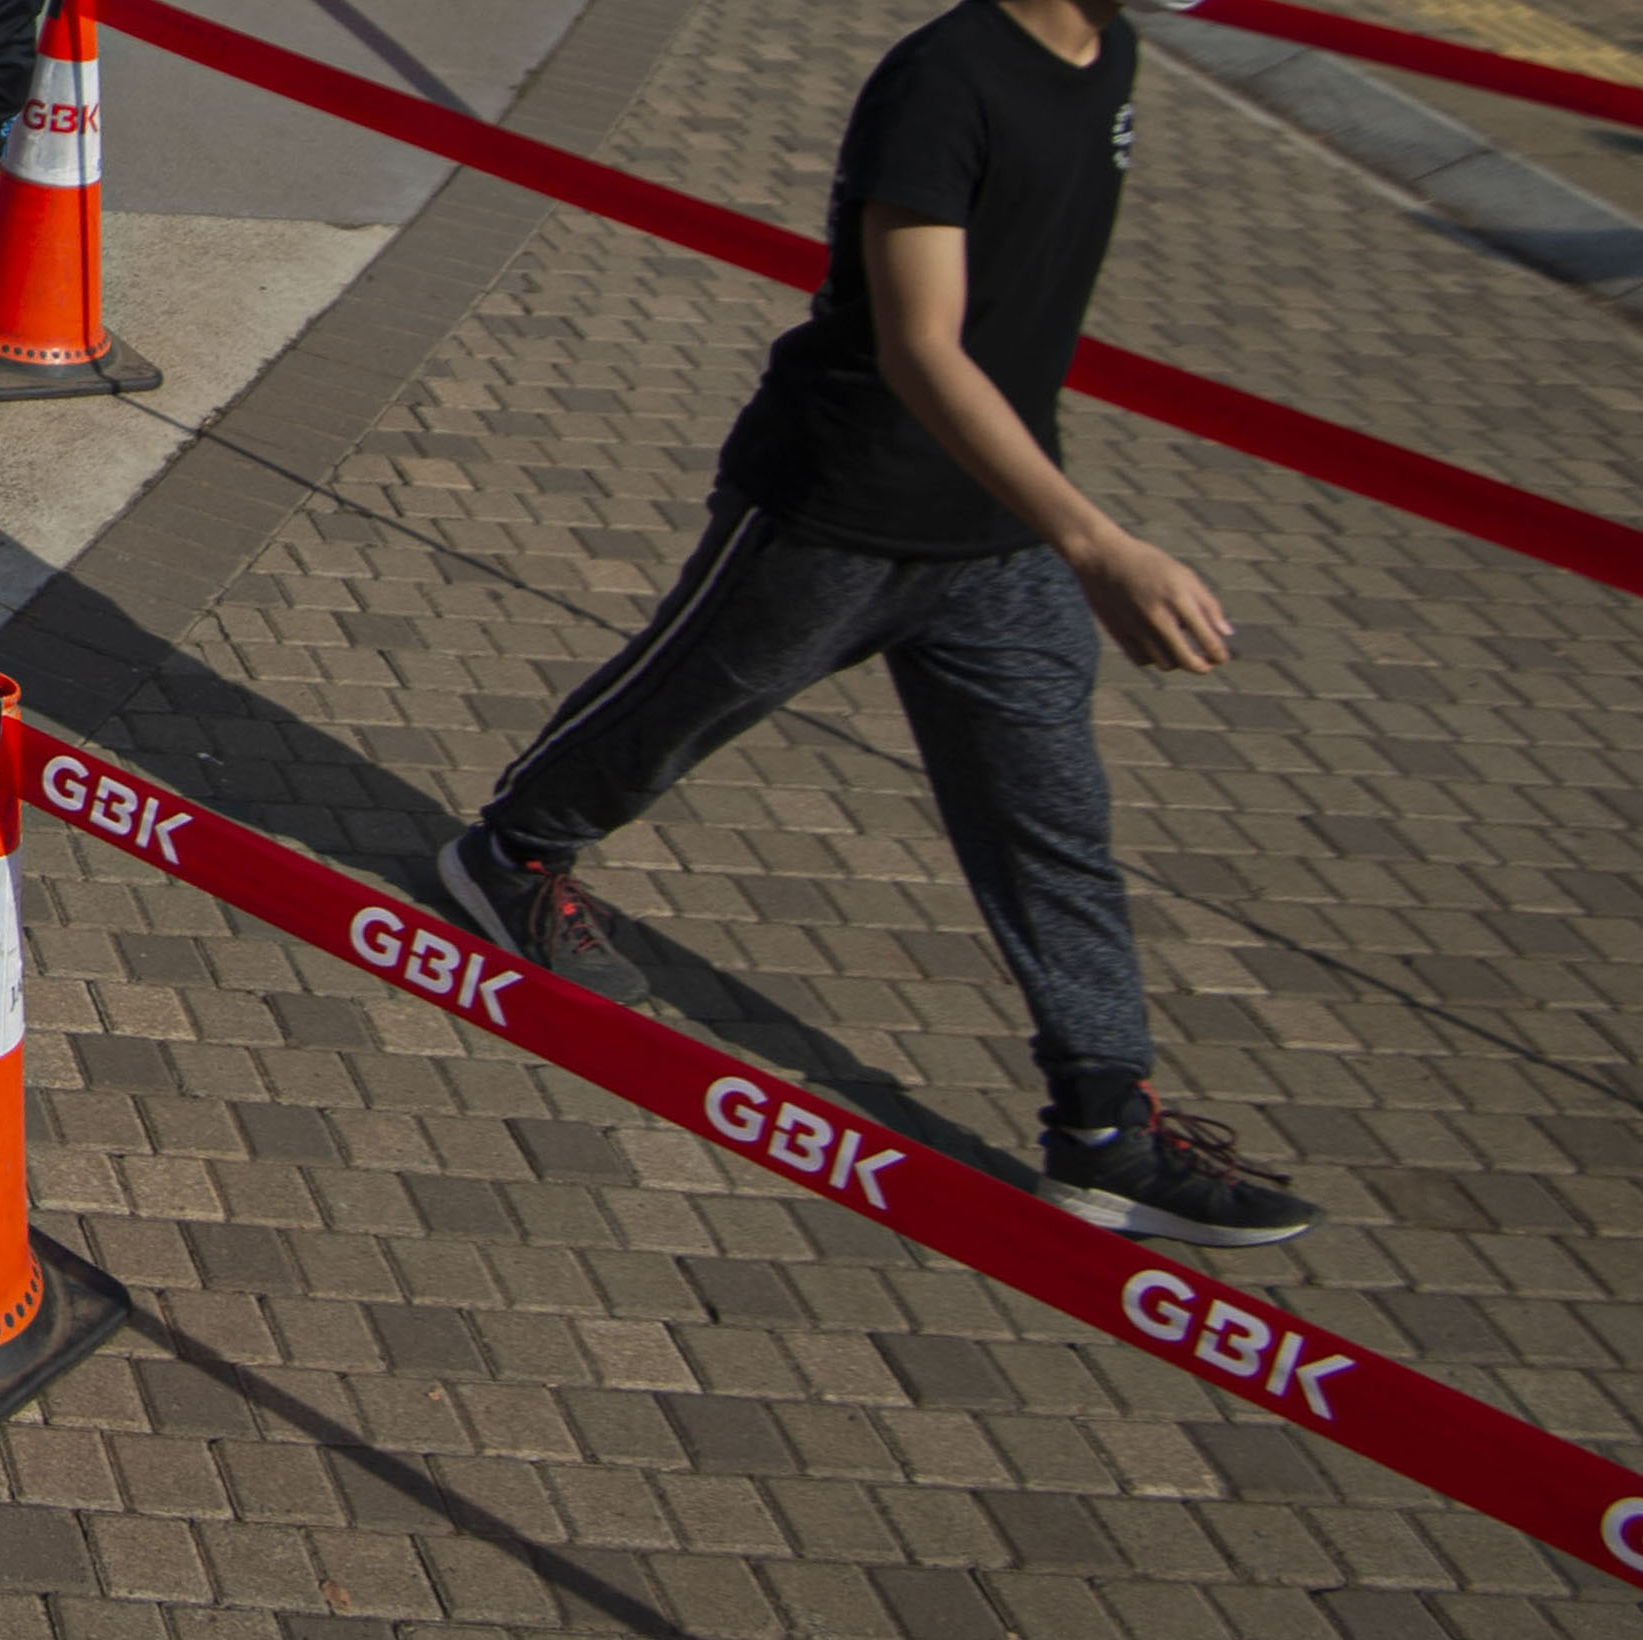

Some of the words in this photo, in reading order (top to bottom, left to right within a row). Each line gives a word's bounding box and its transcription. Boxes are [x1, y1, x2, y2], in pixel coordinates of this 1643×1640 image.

[23, 98, 100, 135] GBK
[42, 754, 193, 864] GBK
[349, 905, 523, 1028] GBK
[702, 1072, 909, 1212] GBK
[1121, 1268, 1356, 1424] GBK
